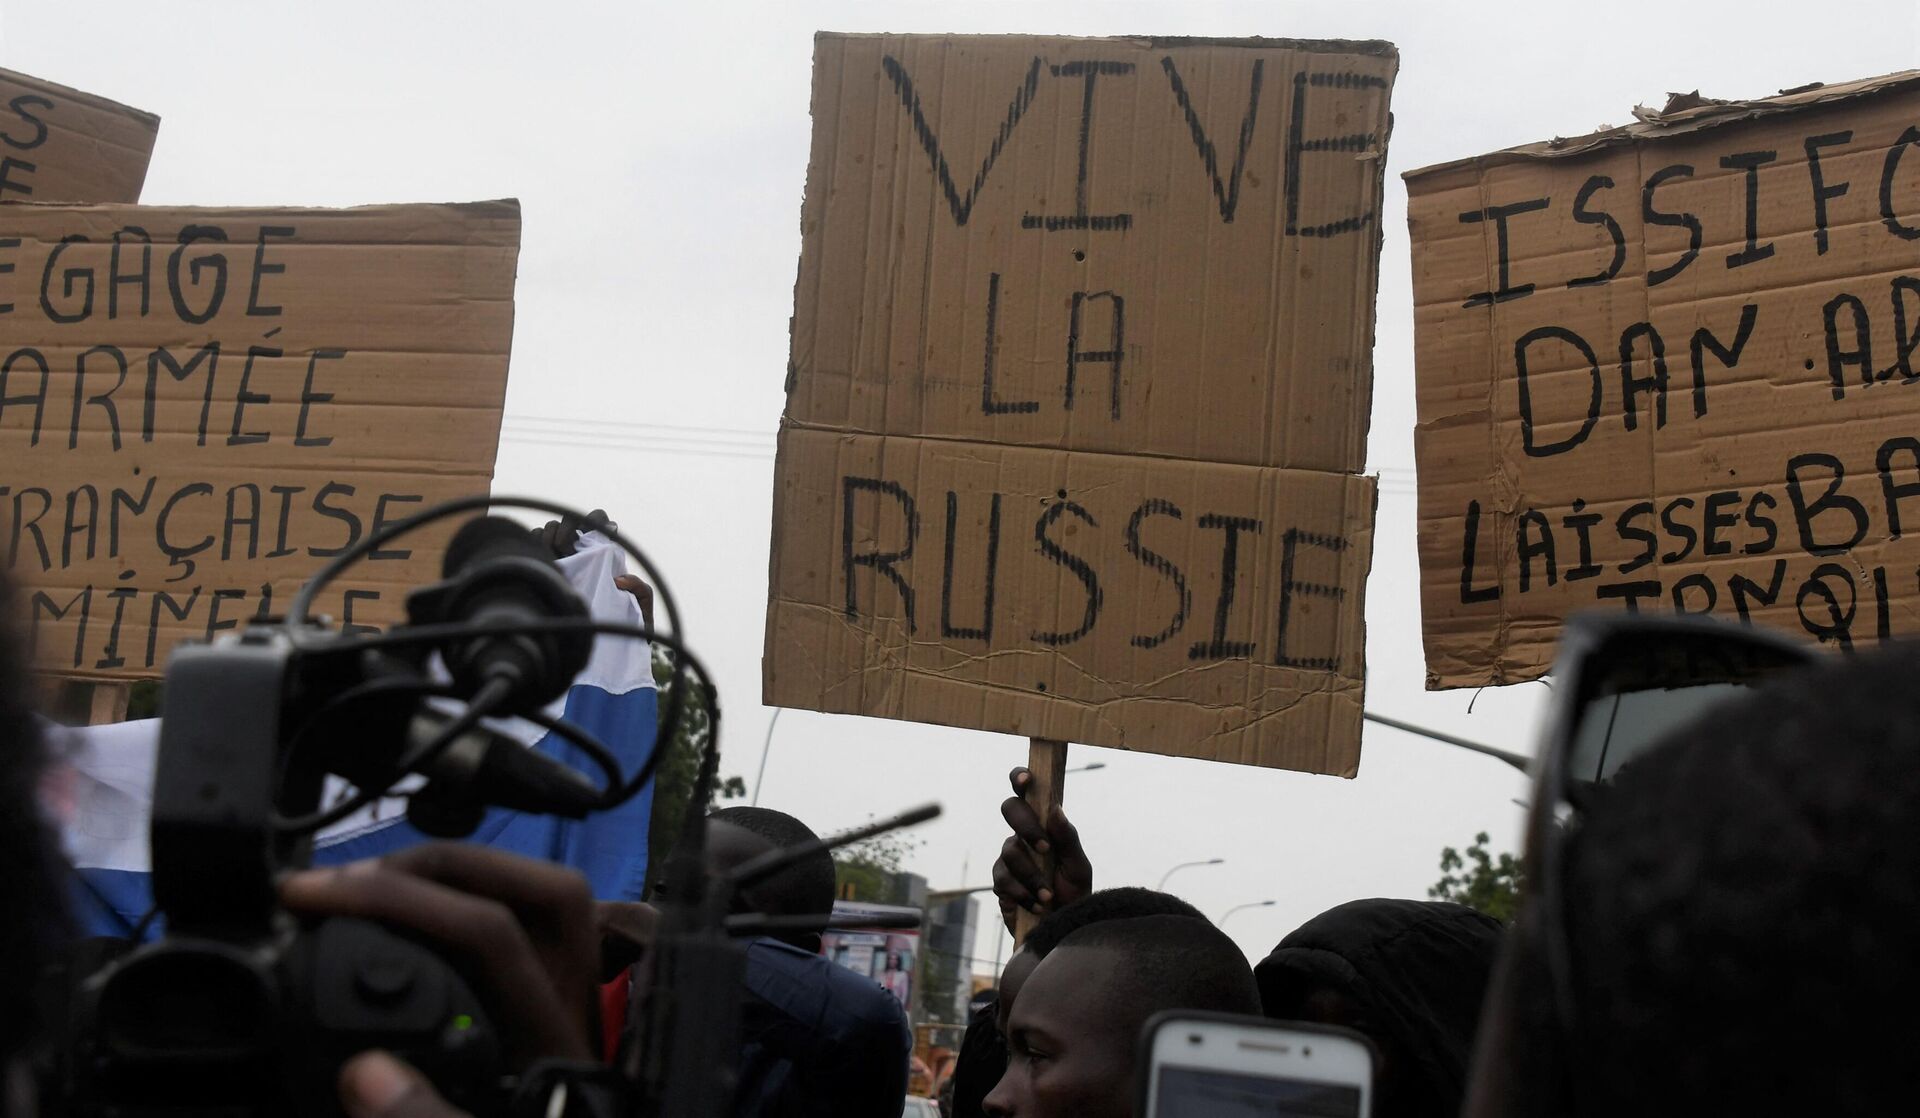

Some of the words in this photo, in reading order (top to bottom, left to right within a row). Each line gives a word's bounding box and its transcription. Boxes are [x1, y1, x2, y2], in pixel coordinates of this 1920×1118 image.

[882, 54, 1388, 237] VIVE
[0, 327, 348, 452] ARMÉE
[982, 273, 1125, 421] LA
[1515, 304, 1758, 457] DAN
[0, 476, 424, 582] RANÇAISE
[843, 476, 1354, 670] RUSSIE
[1460, 491, 1778, 604] LAISSES
